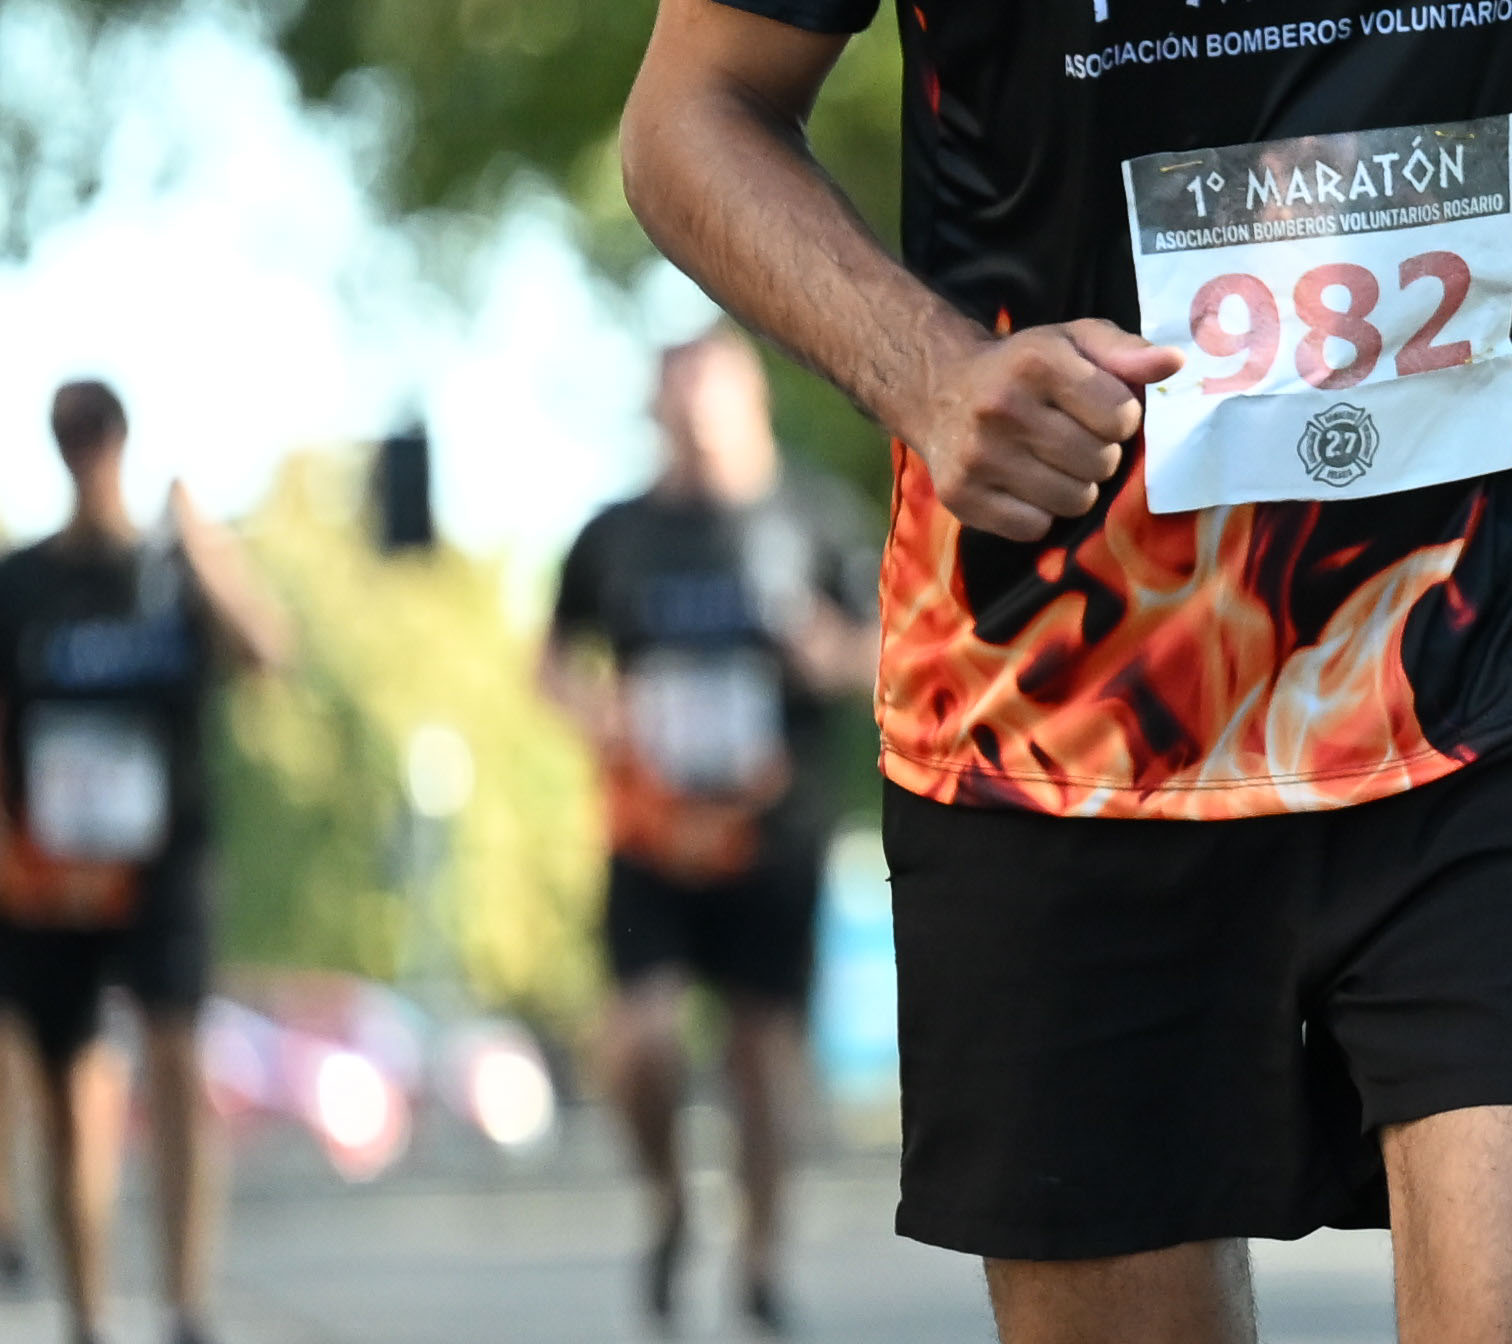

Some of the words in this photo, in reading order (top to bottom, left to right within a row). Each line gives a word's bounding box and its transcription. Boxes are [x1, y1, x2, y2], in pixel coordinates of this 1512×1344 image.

[1065, 32, 1199, 79] ASOCIACIÓN
[1206, 17, 1352, 57] BOMBEROS
[1246, 135, 1465, 211] MARATÓN
[1254, 215, 1336, 241] BOMBEROS
[1340, 203, 1441, 232] VOLUNTARIOS
[1443, 193, 1503, 218] ROSARIO
[1189, 250, 1472, 396] 982
[1325, 430, 1357, 458] 27
